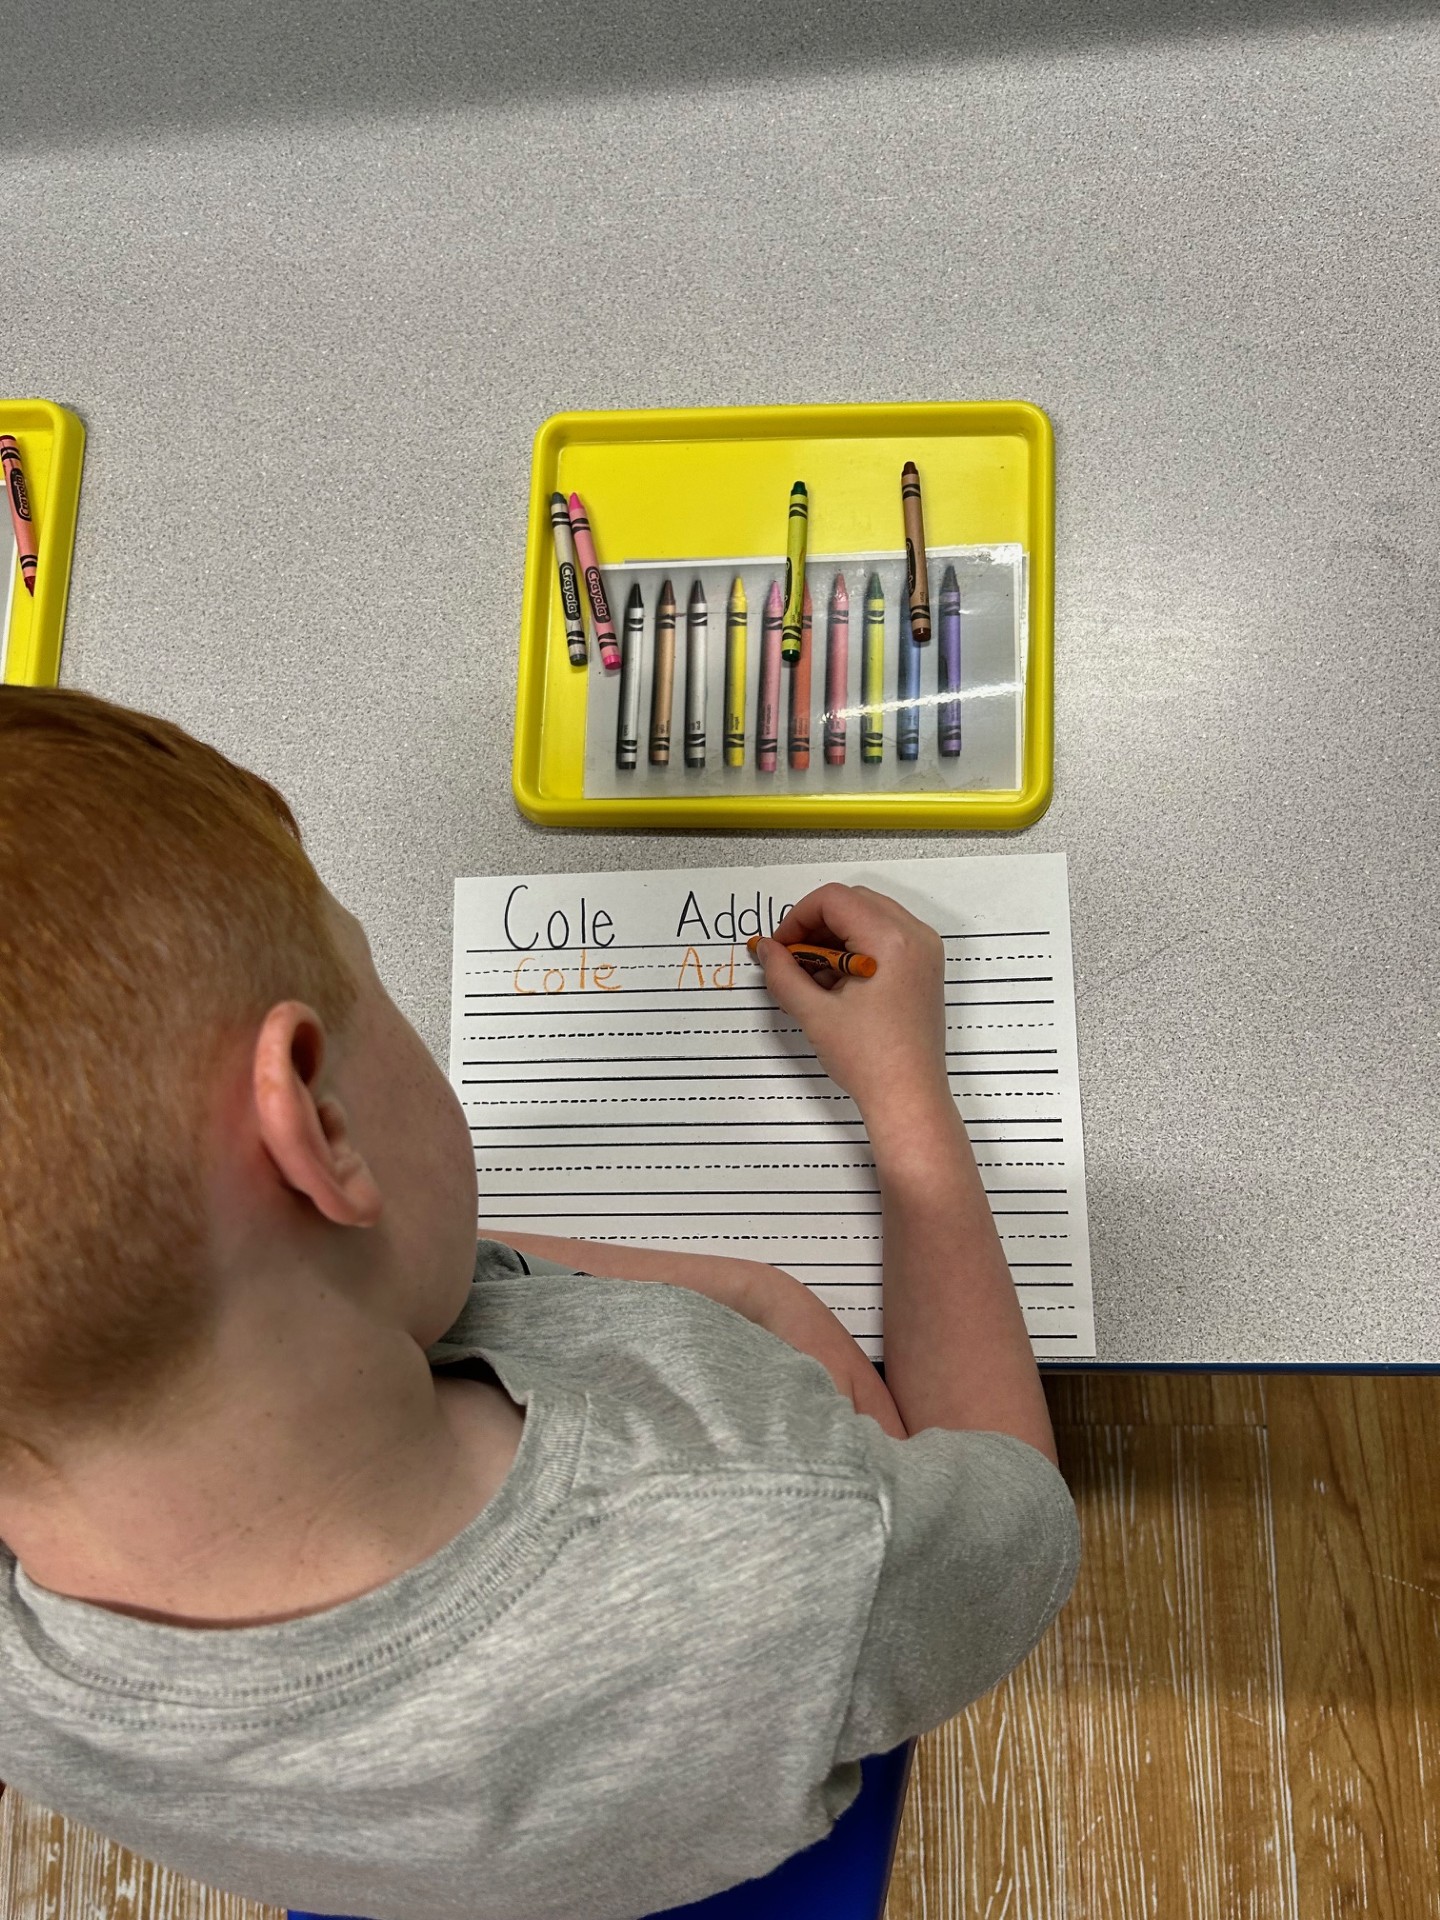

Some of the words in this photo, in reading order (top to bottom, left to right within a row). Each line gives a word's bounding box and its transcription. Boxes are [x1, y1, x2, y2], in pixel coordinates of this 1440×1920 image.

[562, 565, 578, 614] Crayola
[587, 569, 607, 617] Crayola
[504, 884, 616, 950] Cole
[514, 947, 623, 994] Cole
[677, 944, 737, 991] Ad
